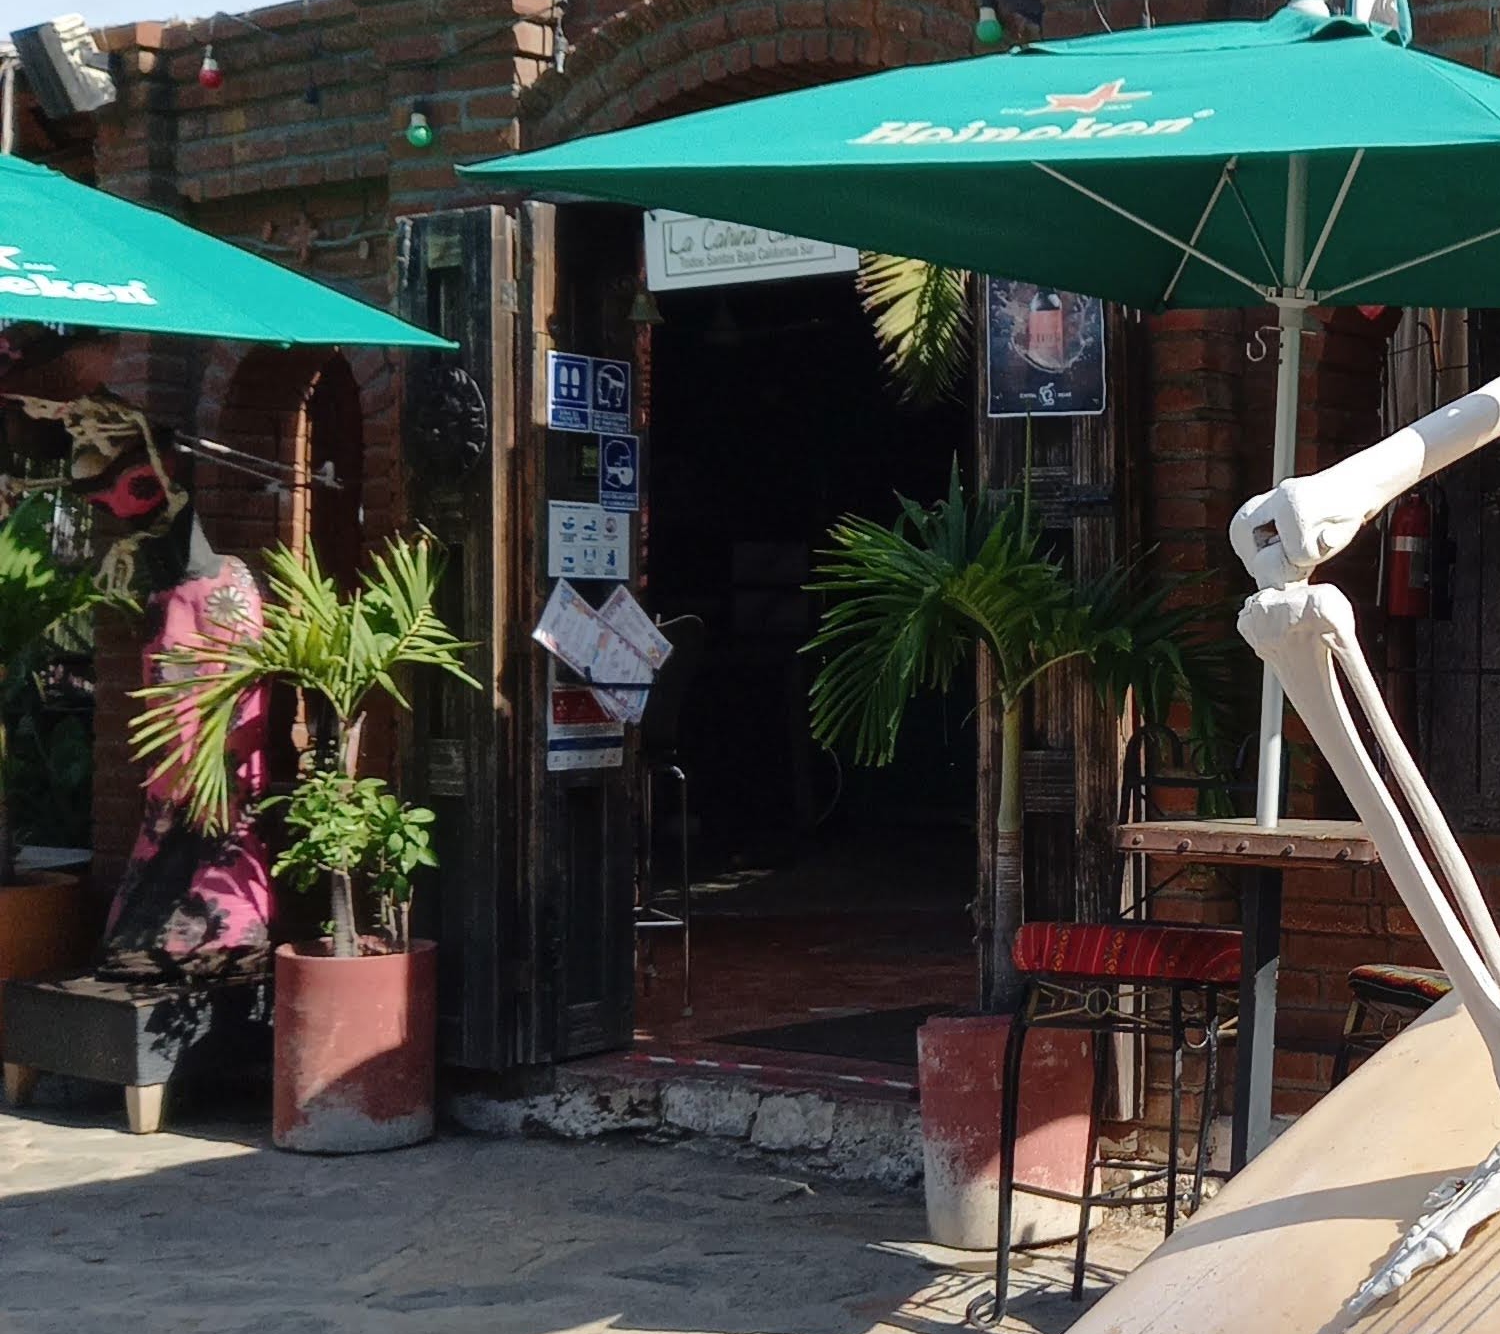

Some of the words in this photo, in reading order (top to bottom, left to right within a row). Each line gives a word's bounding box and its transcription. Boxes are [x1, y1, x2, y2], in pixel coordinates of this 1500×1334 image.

[846, 117, 1194, 145] Heineken
[669, 223, 694, 254] La
[707, 252, 735, 266] Santos
[758, 246, 799, 260] California
